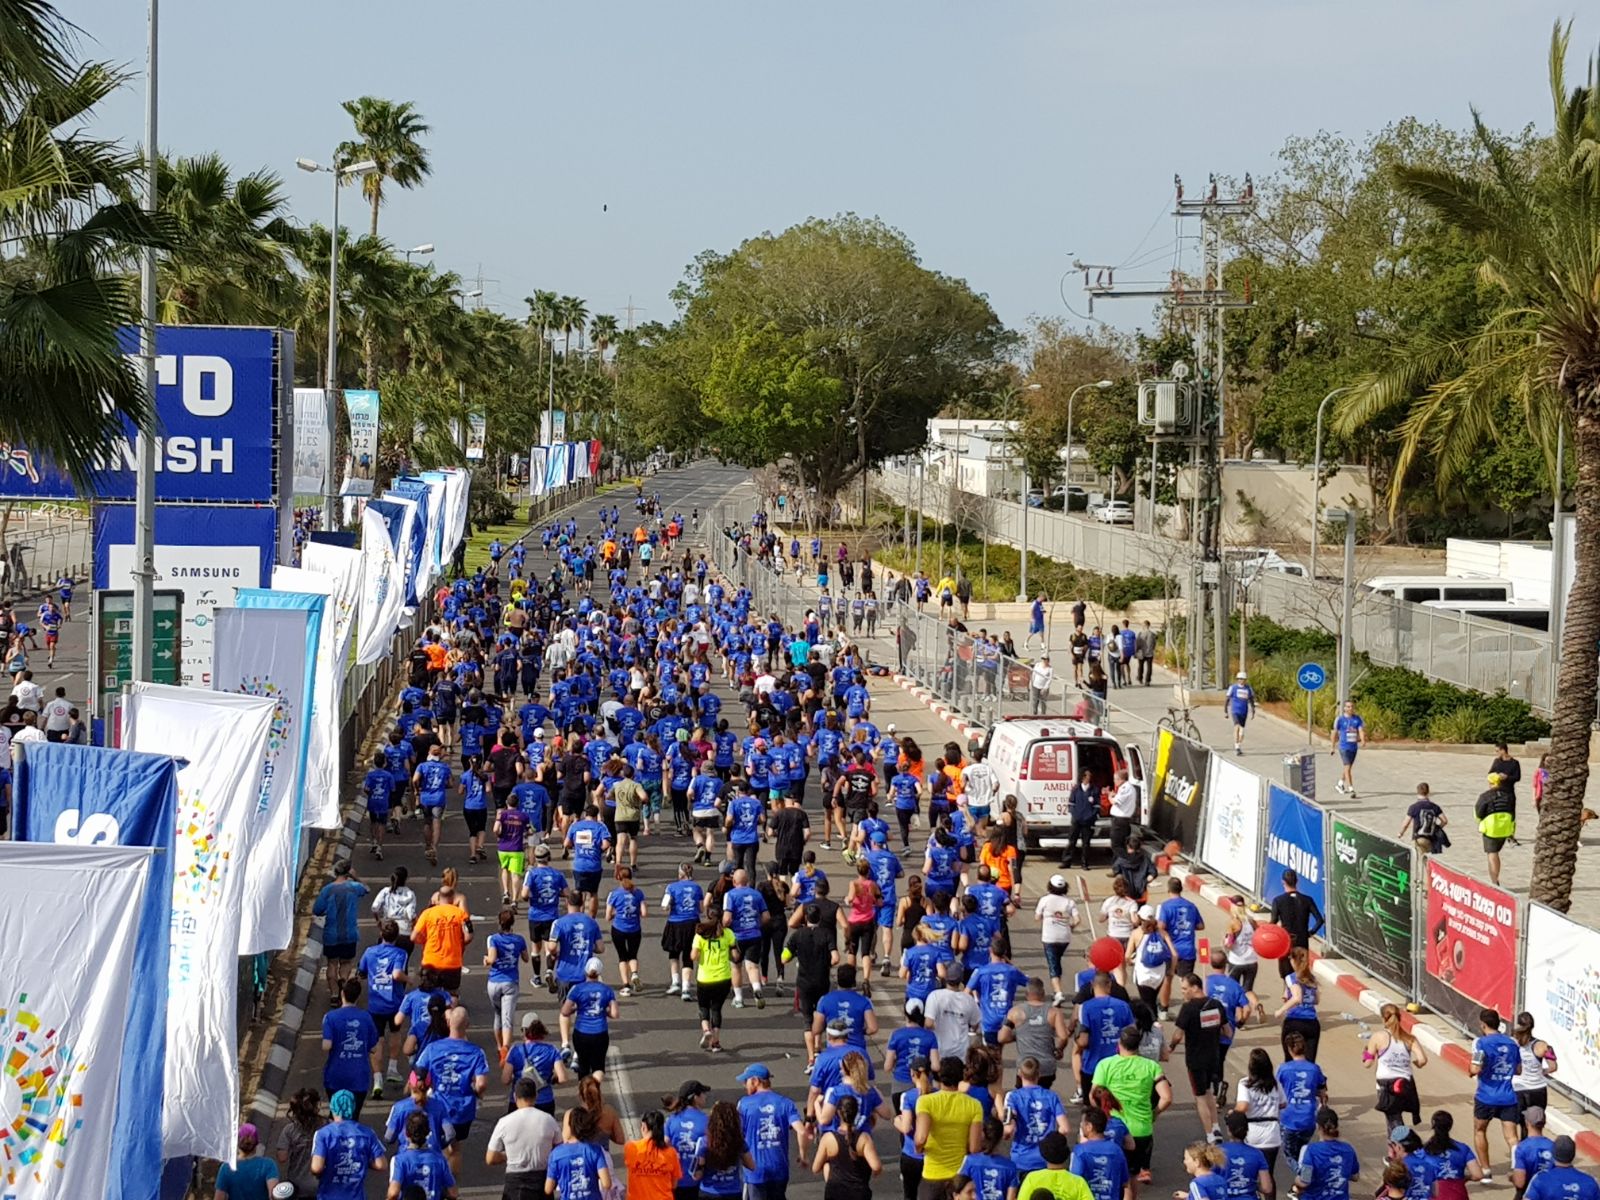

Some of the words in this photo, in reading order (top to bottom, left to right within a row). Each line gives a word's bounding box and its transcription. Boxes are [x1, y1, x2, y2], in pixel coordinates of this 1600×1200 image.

[353, 437, 369, 448] 3.2
[92, 436, 233, 474] INISH
[171, 567, 240, 578] SAMSUNG
[1268, 832, 1318, 884] SAMSUNG
